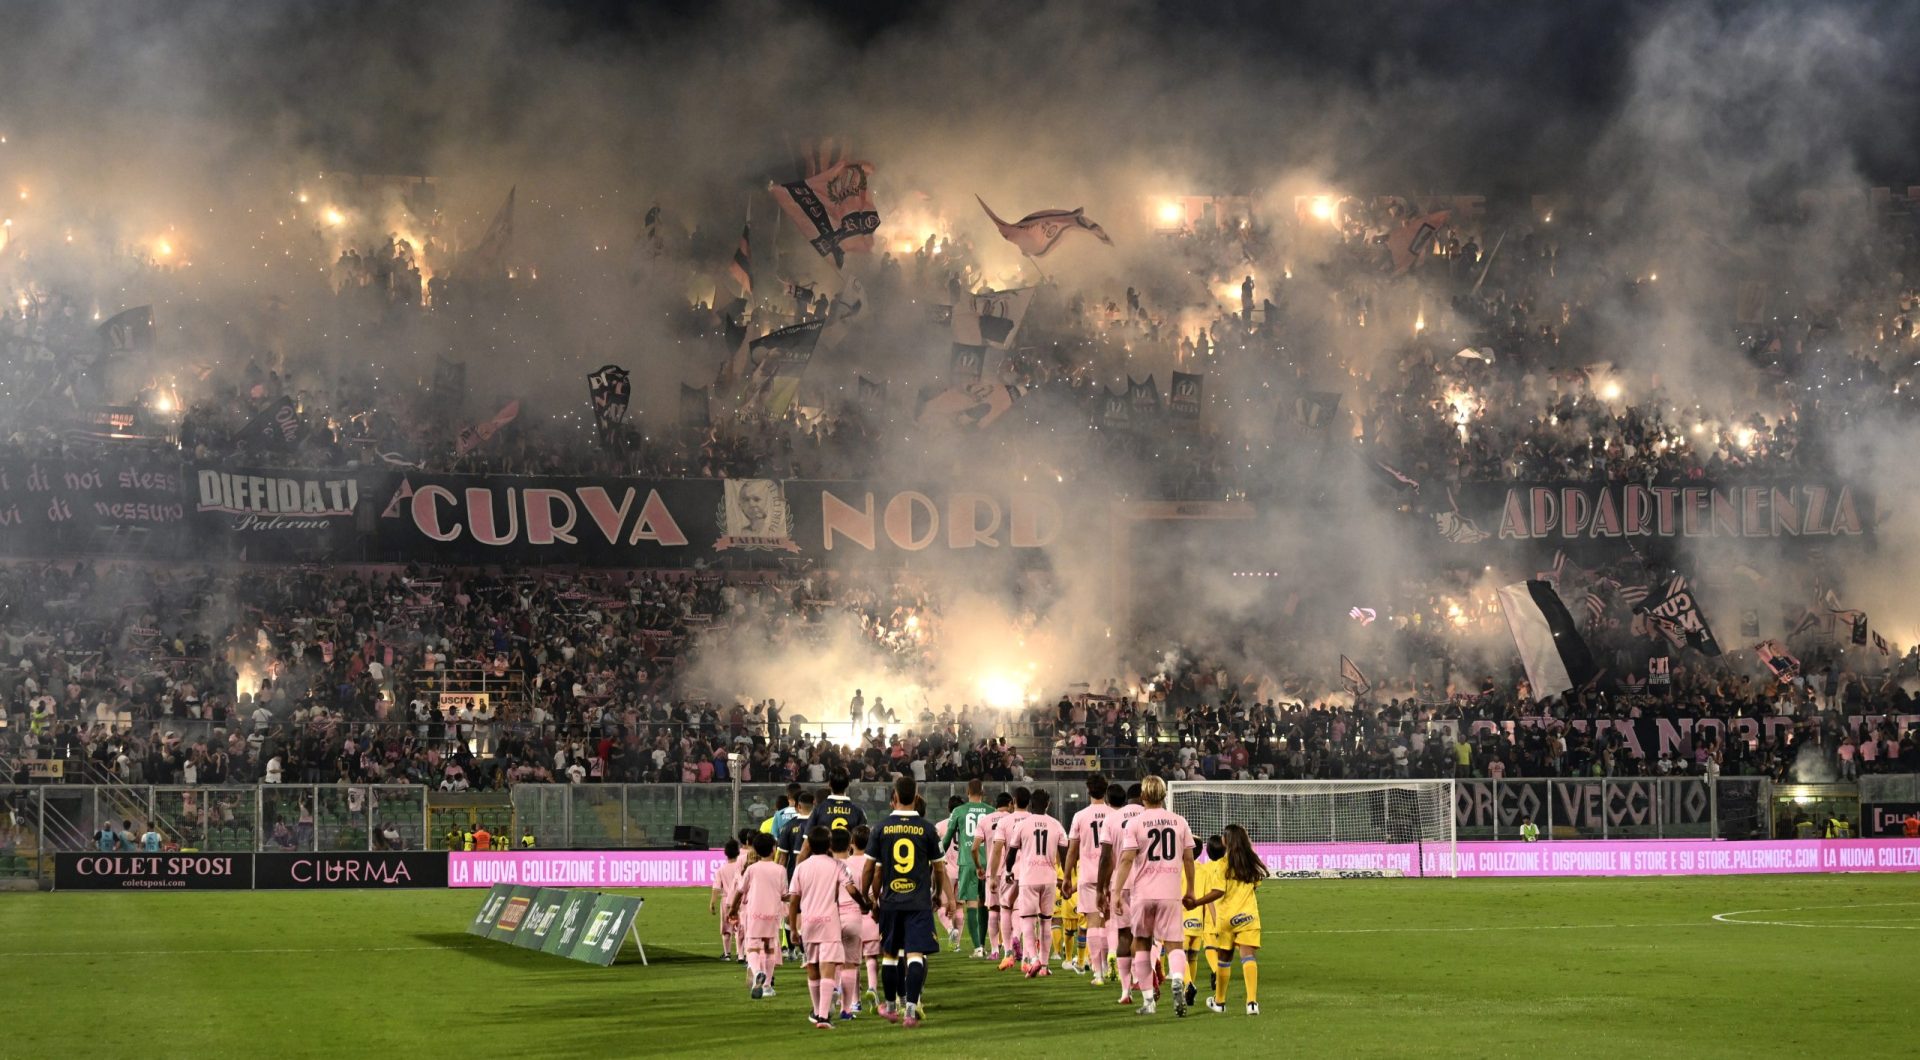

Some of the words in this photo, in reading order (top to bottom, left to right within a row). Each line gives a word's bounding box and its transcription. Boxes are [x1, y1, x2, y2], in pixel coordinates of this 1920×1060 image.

[27, 462, 50, 492] di
[64, 467, 103, 491] noi
[198, 470, 358, 514] DIFFIDATI
[48, 496, 73, 522] di
[231, 512, 331, 531] Palermo
[411, 485, 689, 545] CURVA
[822, 490, 1062, 550] NORD
[1499, 485, 1863, 540] APPARTENENZA
[52, 764, 58, 772] 6
[1051, 758, 1086, 766] USCITA
[1455, 783, 1540, 826] ORGO
[883, 824, 924, 836] RAIMONDO
[1033, 829, 1048, 855] 11
[893, 838, 915, 874] 9
[1147, 827, 1176, 861] 20
[76, 857, 163, 875] COLET
[167, 857, 233, 875] SPOSI
[291, 860, 411, 883] CIURMA
[453, 860, 469, 882] LA
[473, 860, 518, 882] NUOVA
[522, 860, 594, 882] COLLEZIONE
[599, 855, 606, 882] È
[610, 859, 688, 882] DISPONIBILE
[692, 859, 706, 882] IN
[1423, 853, 1436, 872] LA
[1480, 851, 1539, 872] COLLEZIONE
[1543, 847, 1549, 871] È
[1553, 851, 1617, 871] DISPONIBILE
[1620, 851, 1631, 870] IN
[1634, 850, 1668, 871] STORE
[1670, 850, 1677, 870] E
[1679, 850, 1694, 870] SU
[1697, 848, 1818, 870] STORE.PALERMOFC.COM
[1824, 848, 1836, 867] LA
[1840, 847, 1875, 867] NUOVA
[122, 879, 186, 889] coletsposi.com
